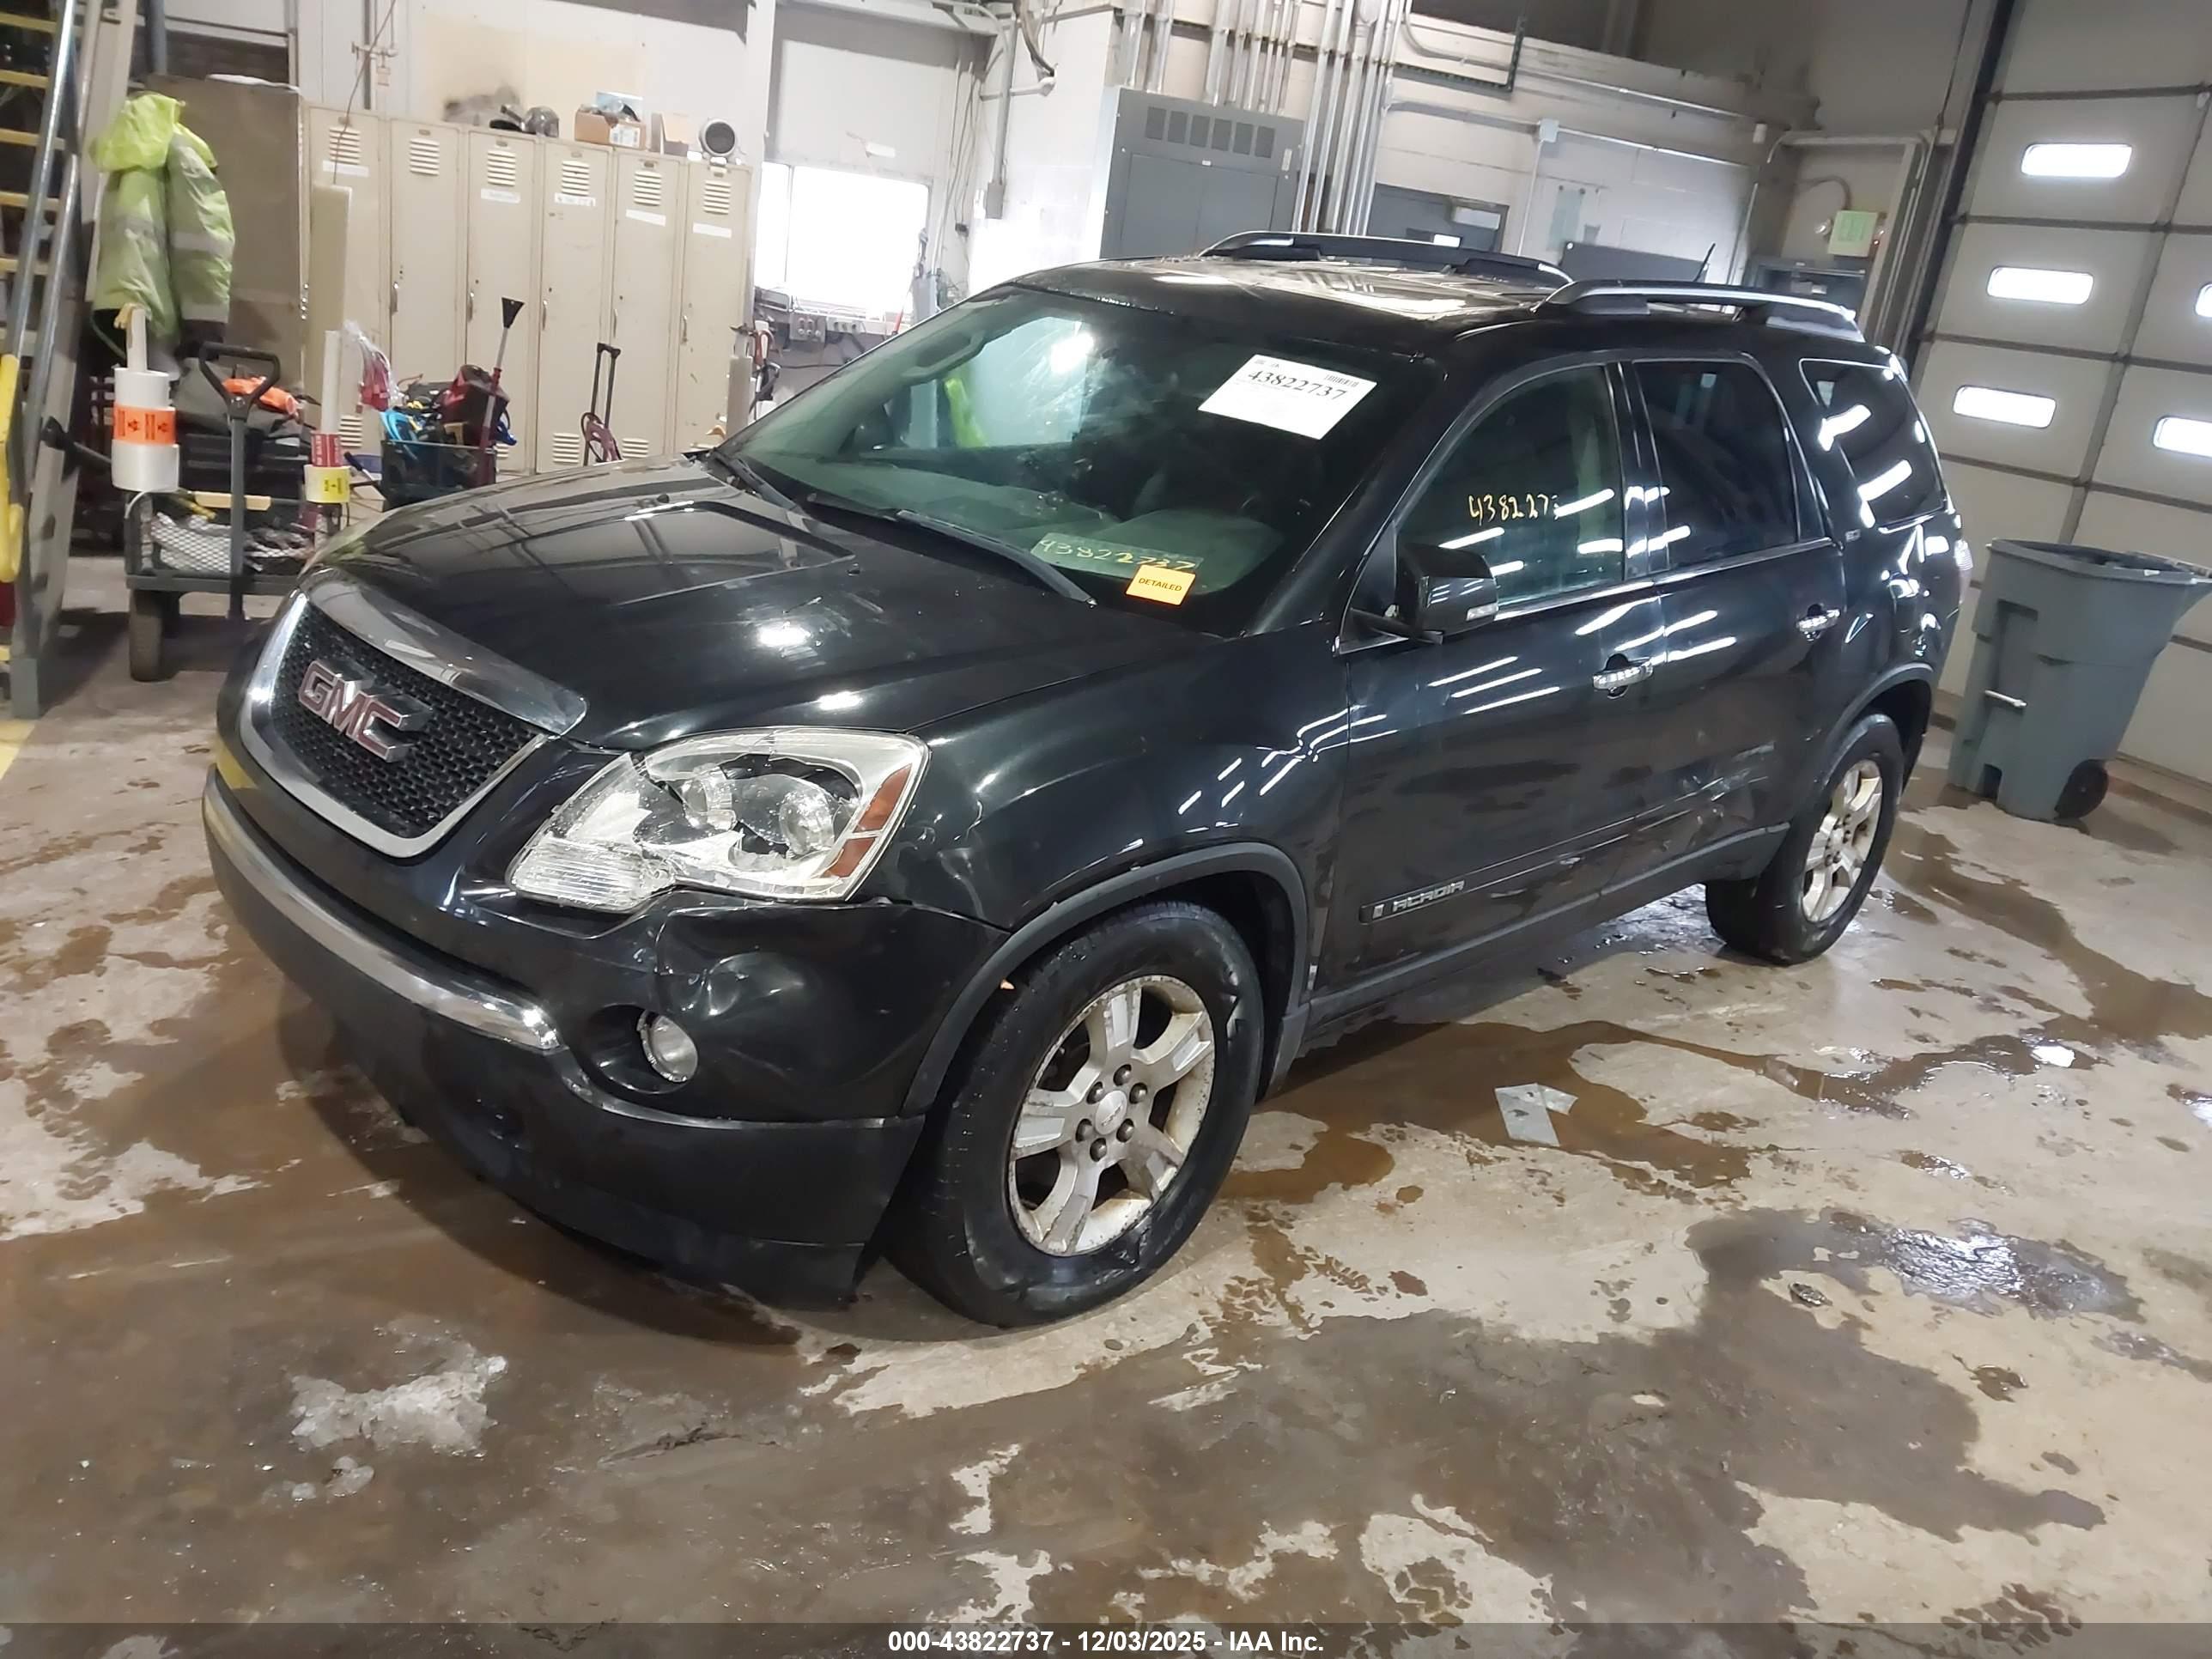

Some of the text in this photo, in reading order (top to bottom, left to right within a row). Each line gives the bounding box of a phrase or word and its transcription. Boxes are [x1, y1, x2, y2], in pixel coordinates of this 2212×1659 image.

[1248, 370, 1347, 400] 43822737
[1139, 577, 1182, 592] DETAILED
[298, 659, 412, 763] GMC
[1392, 880, 1465, 912] ACADIA
